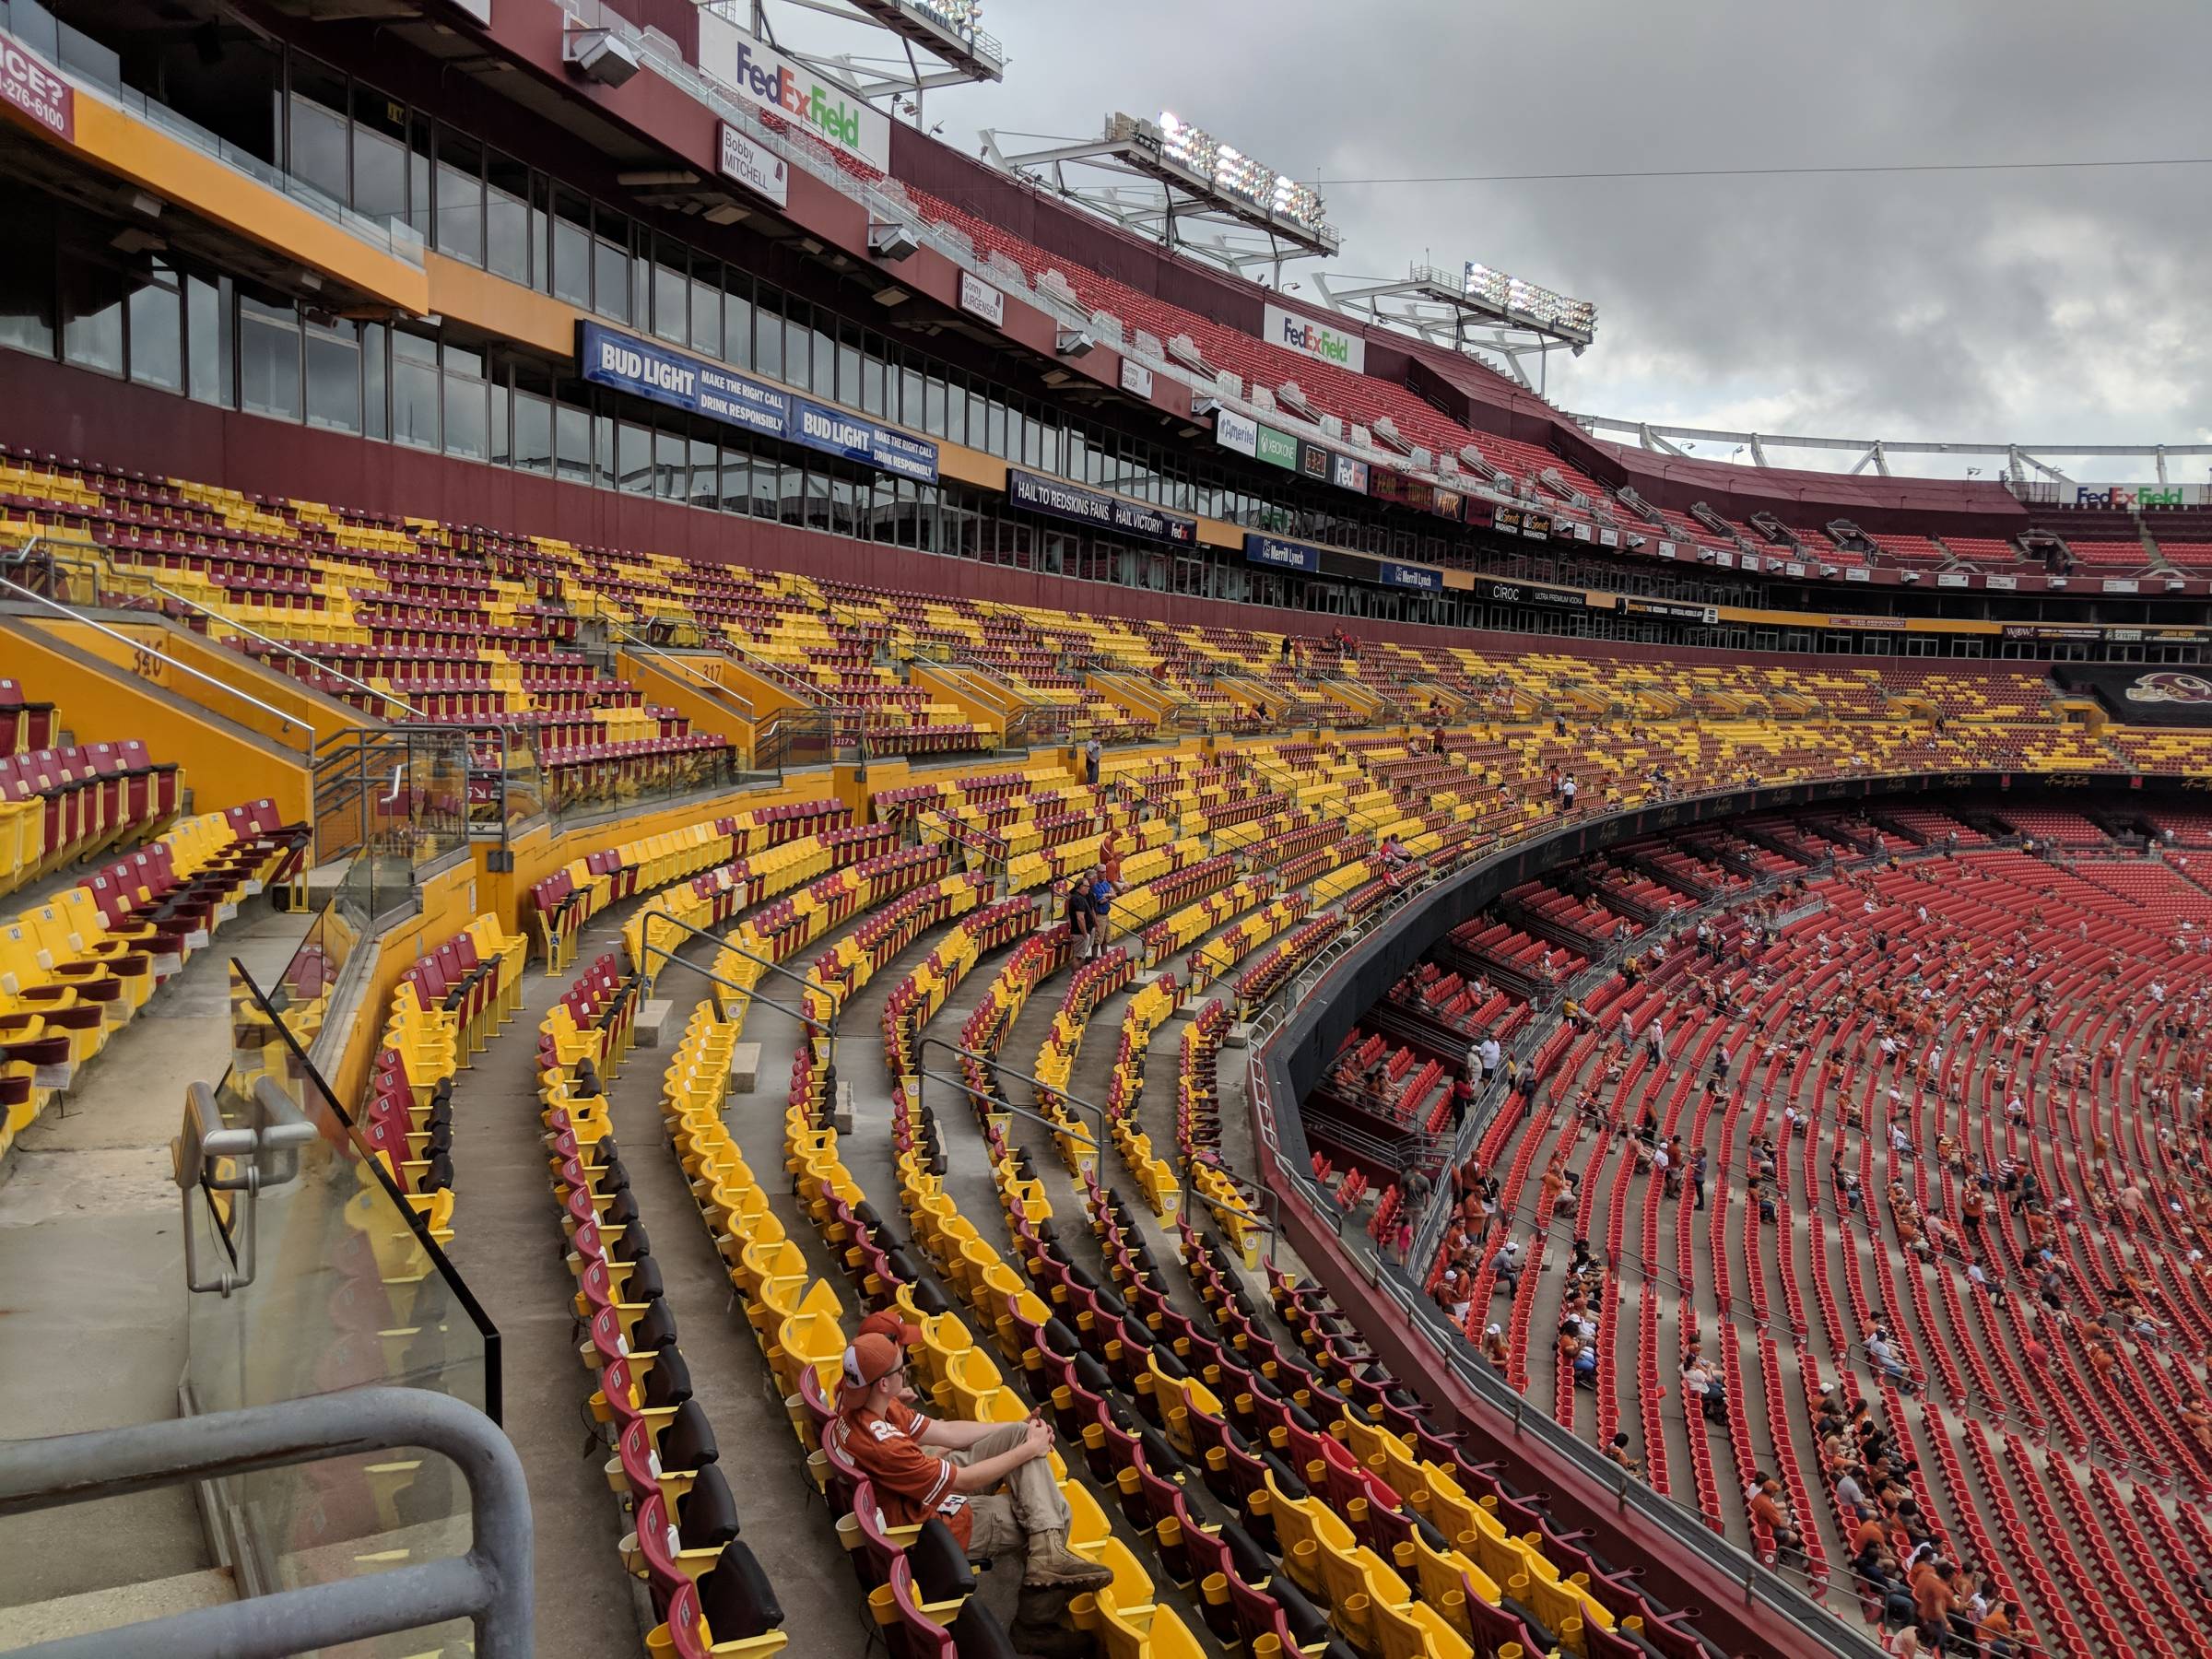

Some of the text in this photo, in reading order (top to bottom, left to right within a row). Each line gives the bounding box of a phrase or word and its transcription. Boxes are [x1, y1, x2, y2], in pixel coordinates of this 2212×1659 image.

[0, 41, 64, 107] CE?
[0, 70, 65, 132] -276-6100
[725, 131, 754, 164] Bobby
[724, 151, 768, 191] MITCHELL
[964, 276, 982, 298] Sonny
[602, 343, 695, 396] BUD LIGHT
[701, 371, 783, 408] MAKE THE RIGHT CALL
[701, 394, 783, 431] DRINK RESPONSIBLY
[804, 411, 870, 452] BUD LIGHT
[875, 429, 933, 459] MAKE THE RIGHT CALL
[1225, 418, 1254, 446] Ameritel
[1268, 436, 1294, 460] XBOX ONE
[874, 449, 933, 477] DRINK RESPONSIBLY
[1338, 457, 1364, 489] FedEx
[1018, 481, 1163, 535] HAIL TO REDSKINS FANS. HAIL VICTORY!
[1171, 523, 1188, 541] FedEx
[1271, 545, 1289, 562] Merrill
[1289, 551, 1304, 566] Lynch
[1402, 570, 1418, 583] Merrill
[1418, 575, 1431, 587] Lynch
[1535, 592, 1583, 605] ULTRA PREMIUM VODKA
[703, 664, 722, 683] 317
[43, 909, 53, 920] 13
[11, 928, 20, 940] 12
